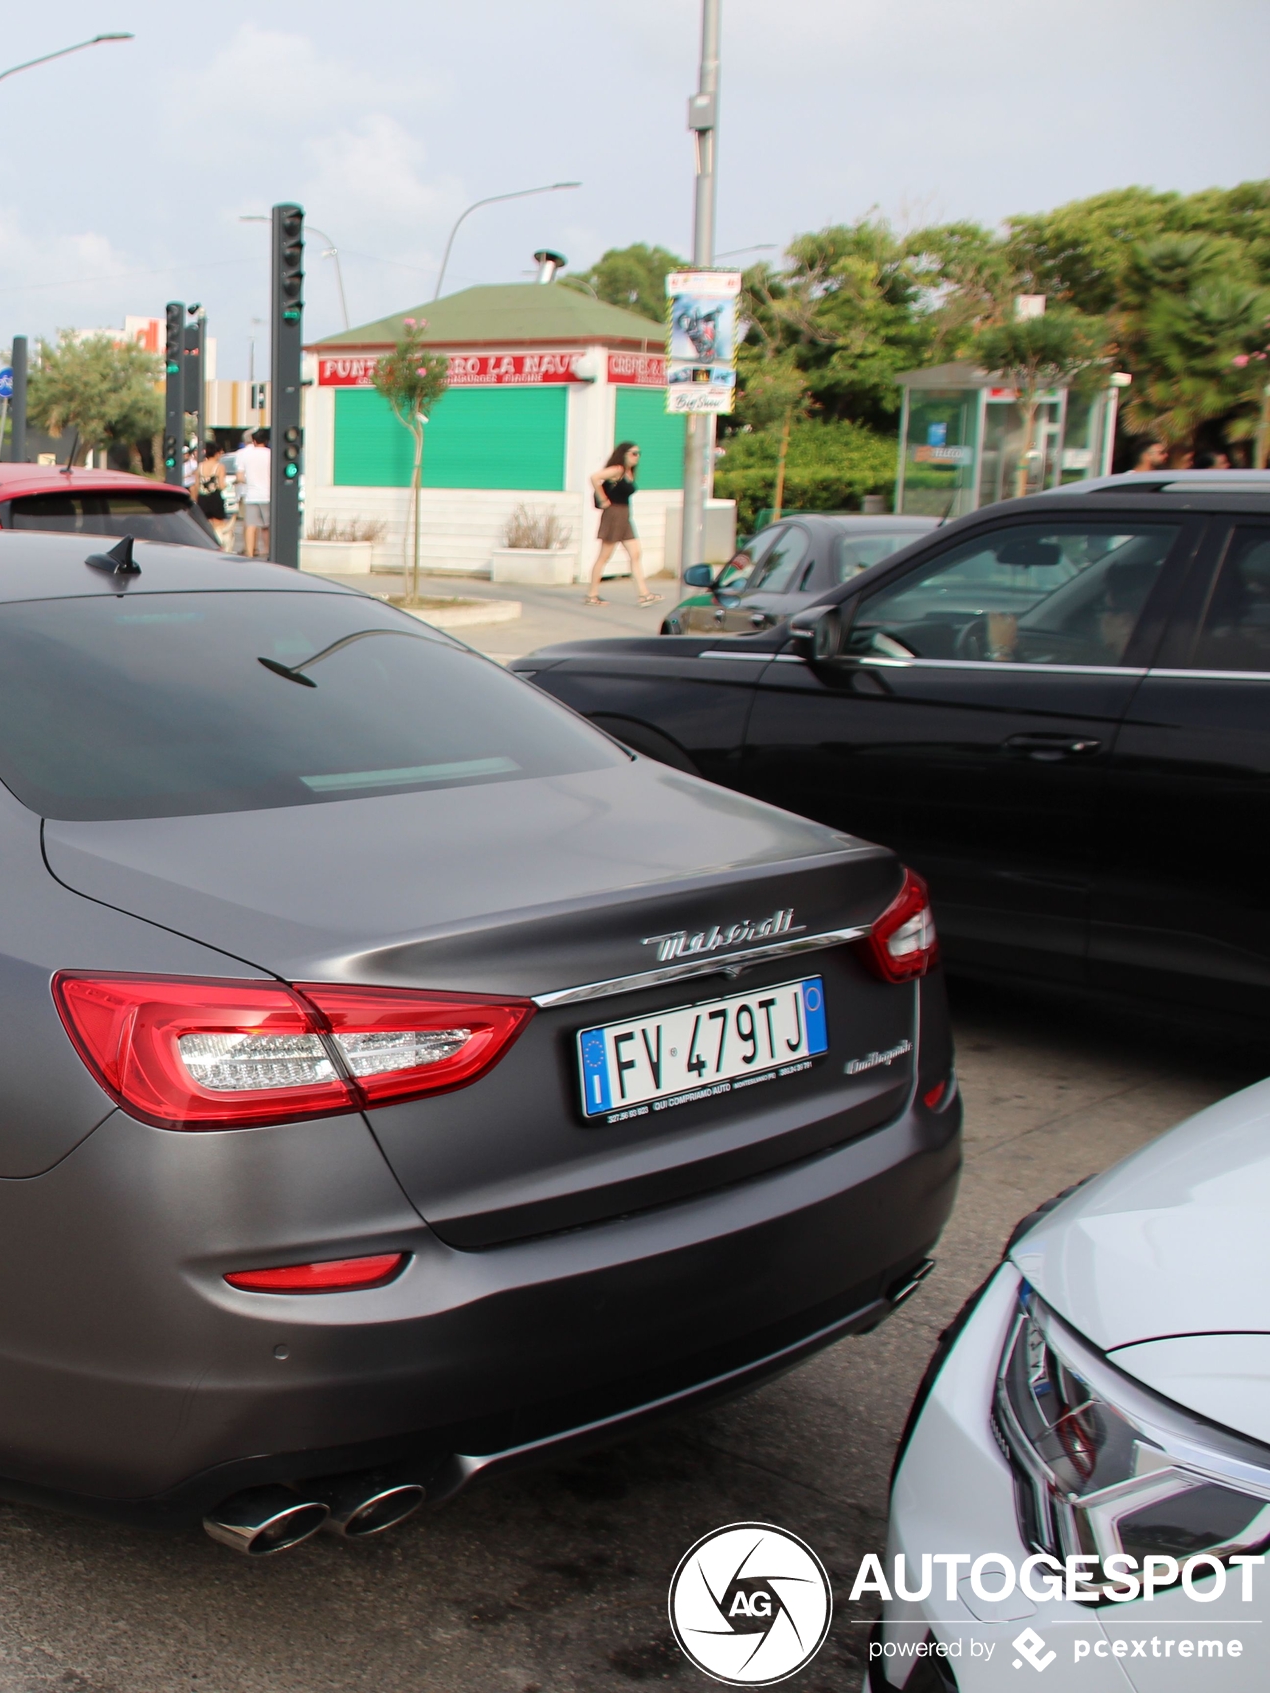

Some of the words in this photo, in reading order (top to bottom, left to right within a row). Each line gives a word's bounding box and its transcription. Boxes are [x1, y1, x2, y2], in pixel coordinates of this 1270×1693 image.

[323, 359, 376, 378] PUNT
[488, 356, 515, 375] LA
[613, 1024, 664, 1100] FV
[686, 991, 806, 1080] 479TJ
[653, 1101, 668, 1112] QUI
[668, 1089, 713, 1106] COMPRIAMO
[713, 1083, 731, 1096] AUTO
